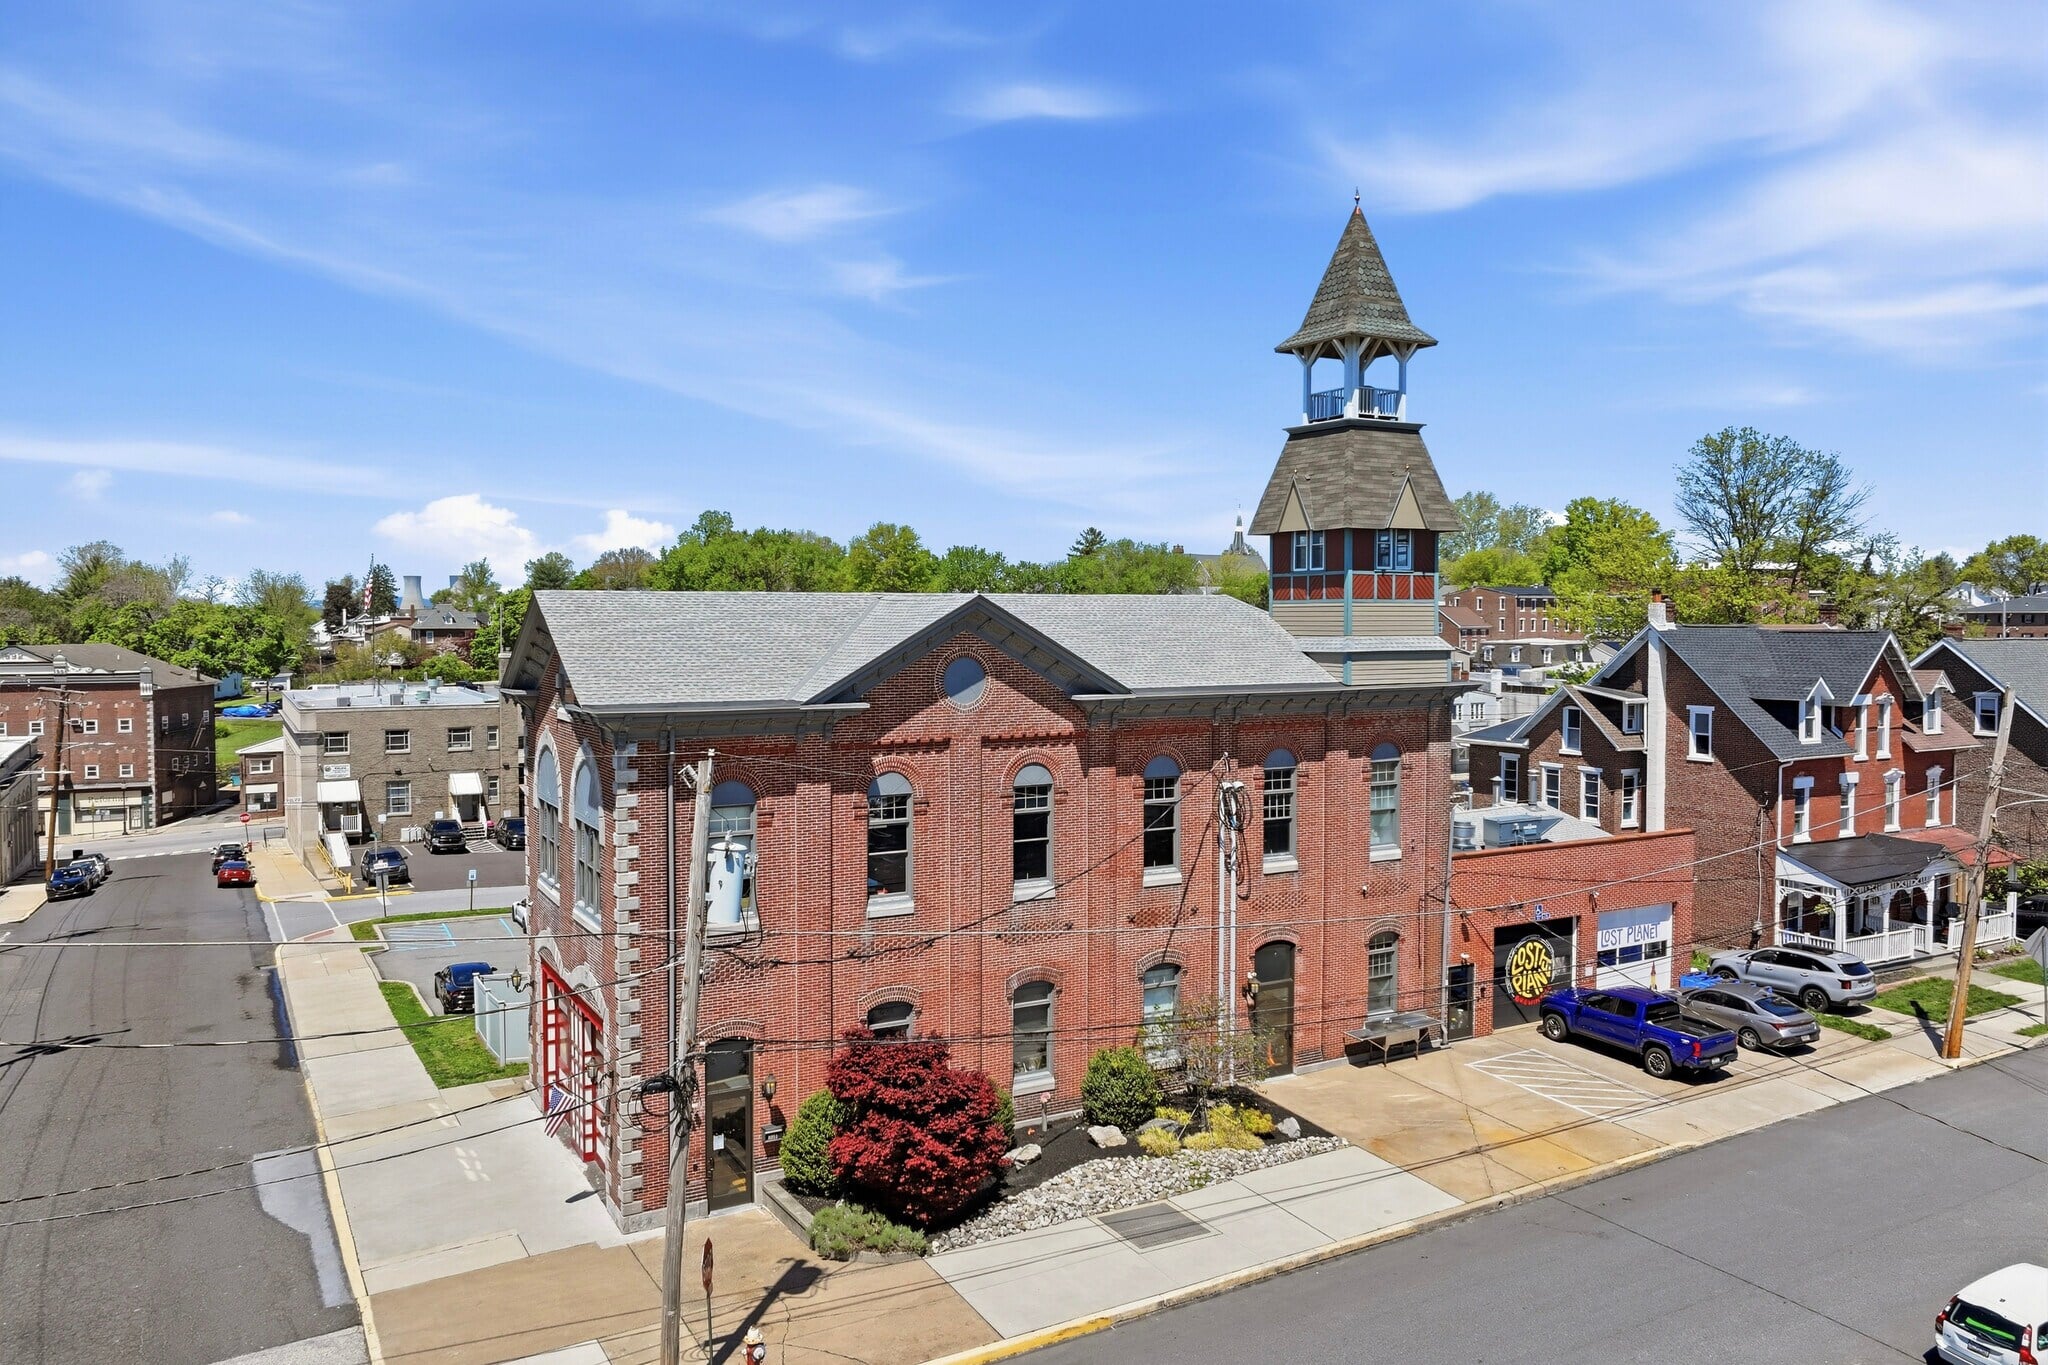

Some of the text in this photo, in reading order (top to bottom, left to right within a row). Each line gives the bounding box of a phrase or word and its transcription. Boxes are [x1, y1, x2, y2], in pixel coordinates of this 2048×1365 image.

[1601, 924, 1659, 948] LOST PLANET
[1512, 942, 1543, 975] LOST
